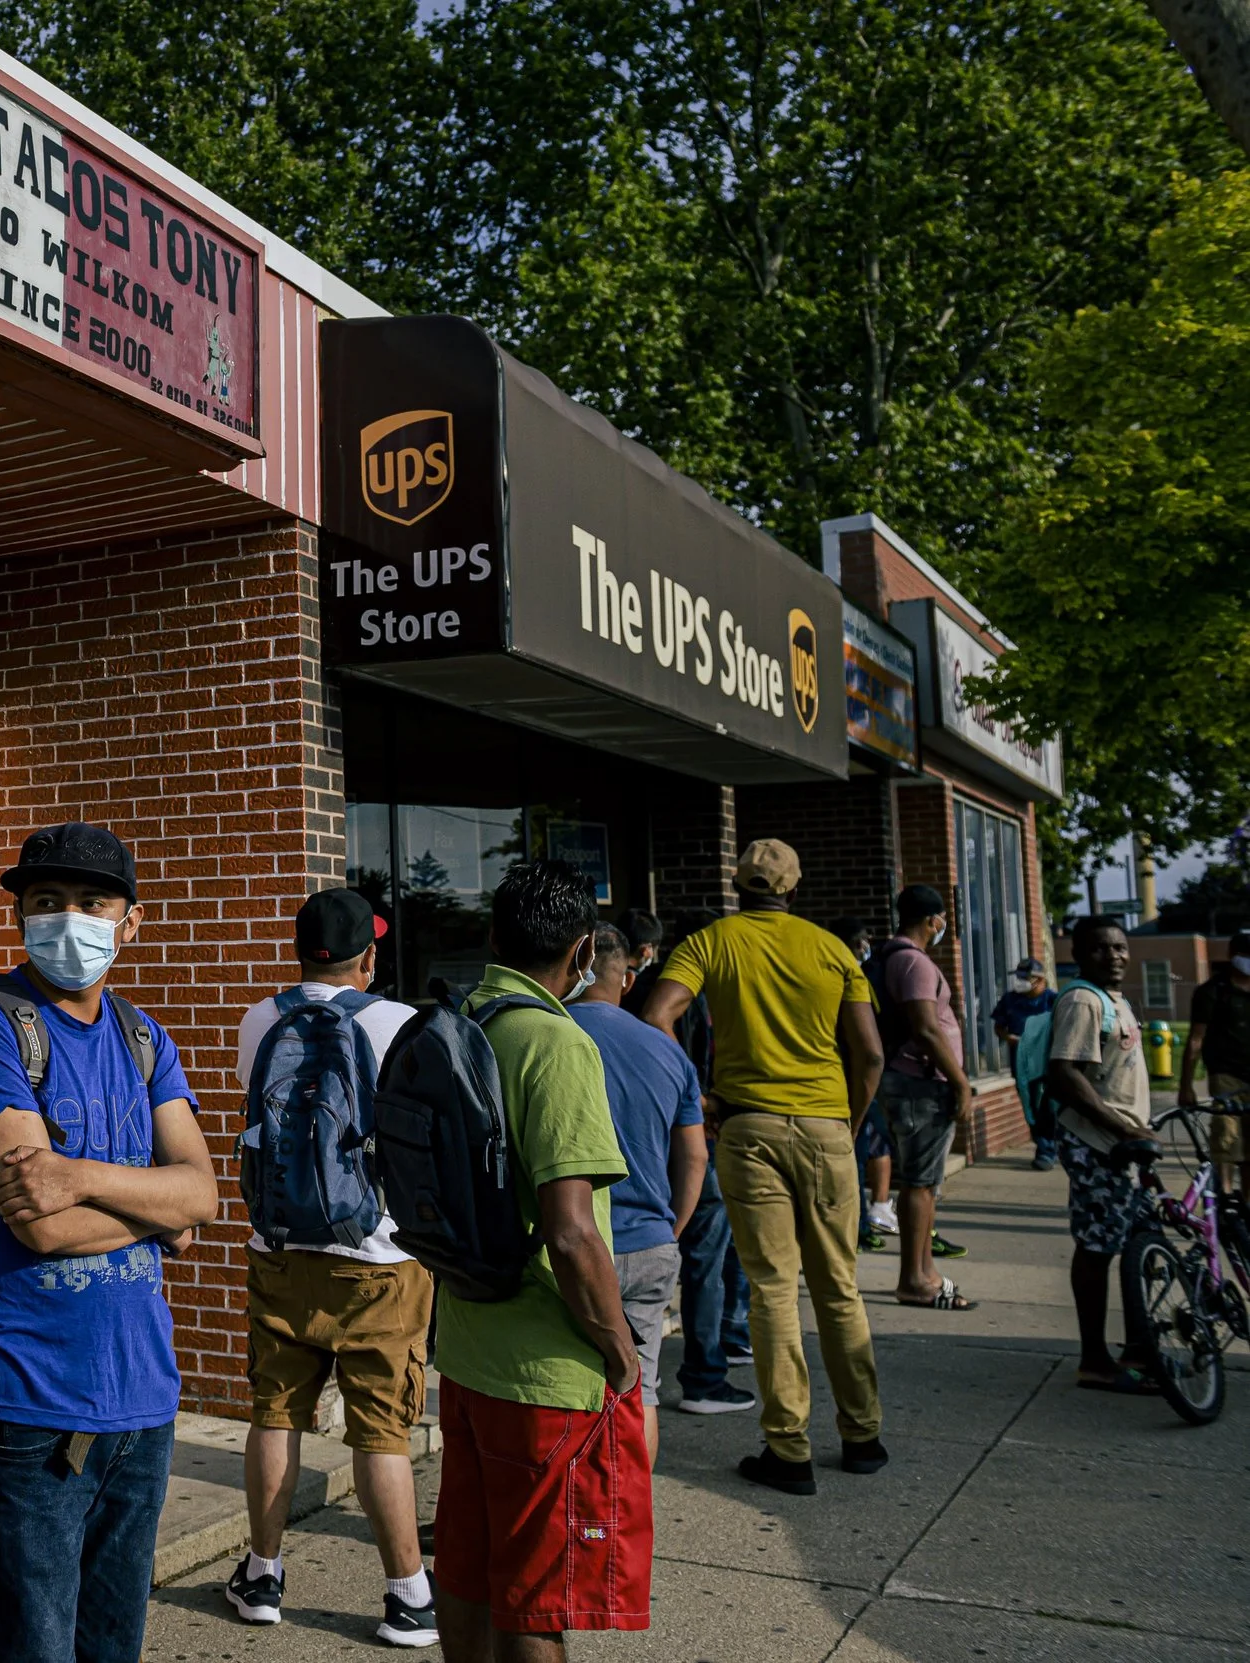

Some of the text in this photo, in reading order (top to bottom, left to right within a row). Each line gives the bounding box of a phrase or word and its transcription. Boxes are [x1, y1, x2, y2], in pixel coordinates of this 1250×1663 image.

[42, 229, 174, 334] WILKOM
[141, 201, 241, 315] TONY
[90, 317, 150, 378] 2000
[368, 442, 447, 508] ups
[330, 544, 492, 597] The UPS
[360, 607, 460, 645] Store
[571, 524, 642, 654] The
[650, 569, 713, 686] UPS
[718, 609, 784, 717] Store
[792, 644, 816, 713] ups
[557, 843, 601, 866] Passport
